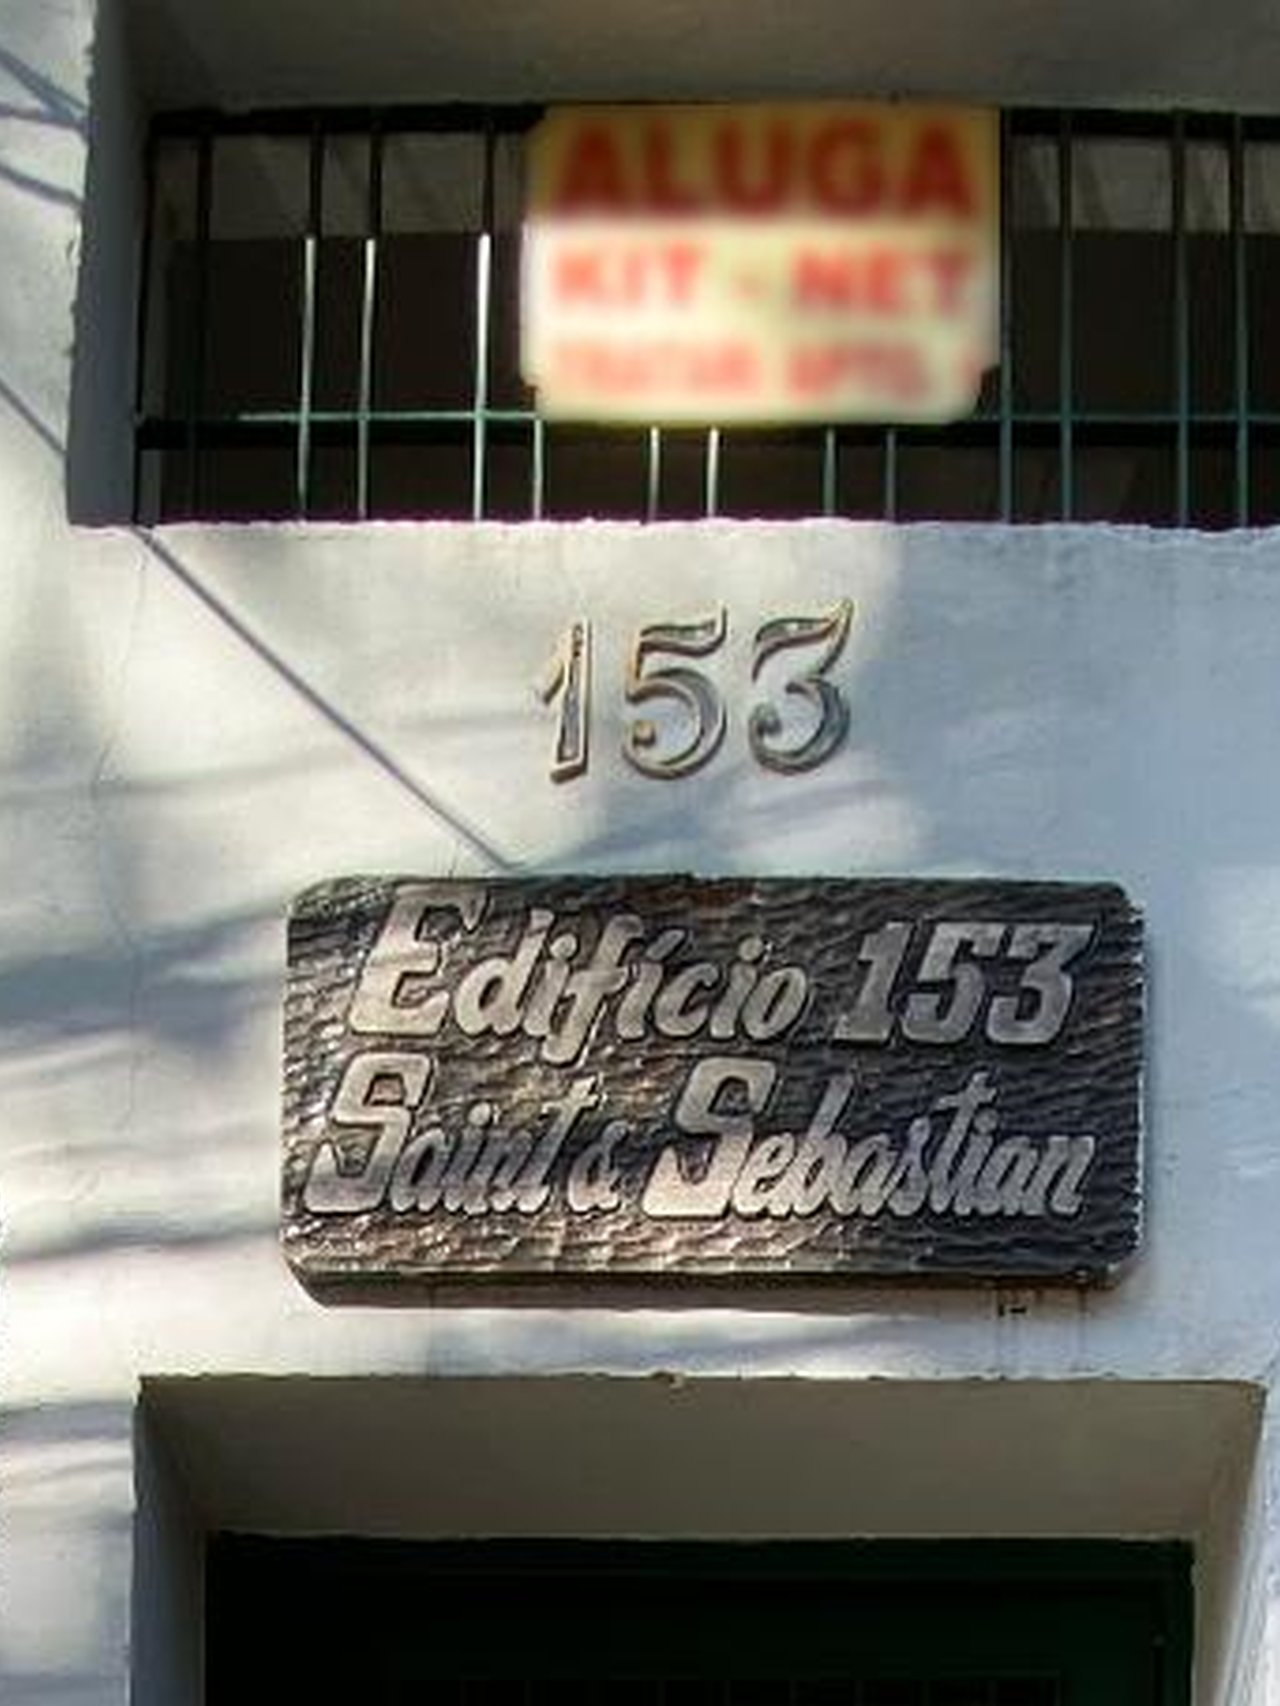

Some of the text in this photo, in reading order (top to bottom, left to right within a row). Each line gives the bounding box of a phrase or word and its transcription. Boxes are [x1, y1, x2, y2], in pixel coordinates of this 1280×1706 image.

[548, 116, 984, 222] ALUGA
[551, 240, 710, 310] KIT
[790, 243, 980, 318] NET
[540, 600, 854, 784] 153
[831, 920, 1100, 1047] 153
[305, 1053, 606, 1217] Saint
[642, 1057, 1099, 1219] Sebastian
